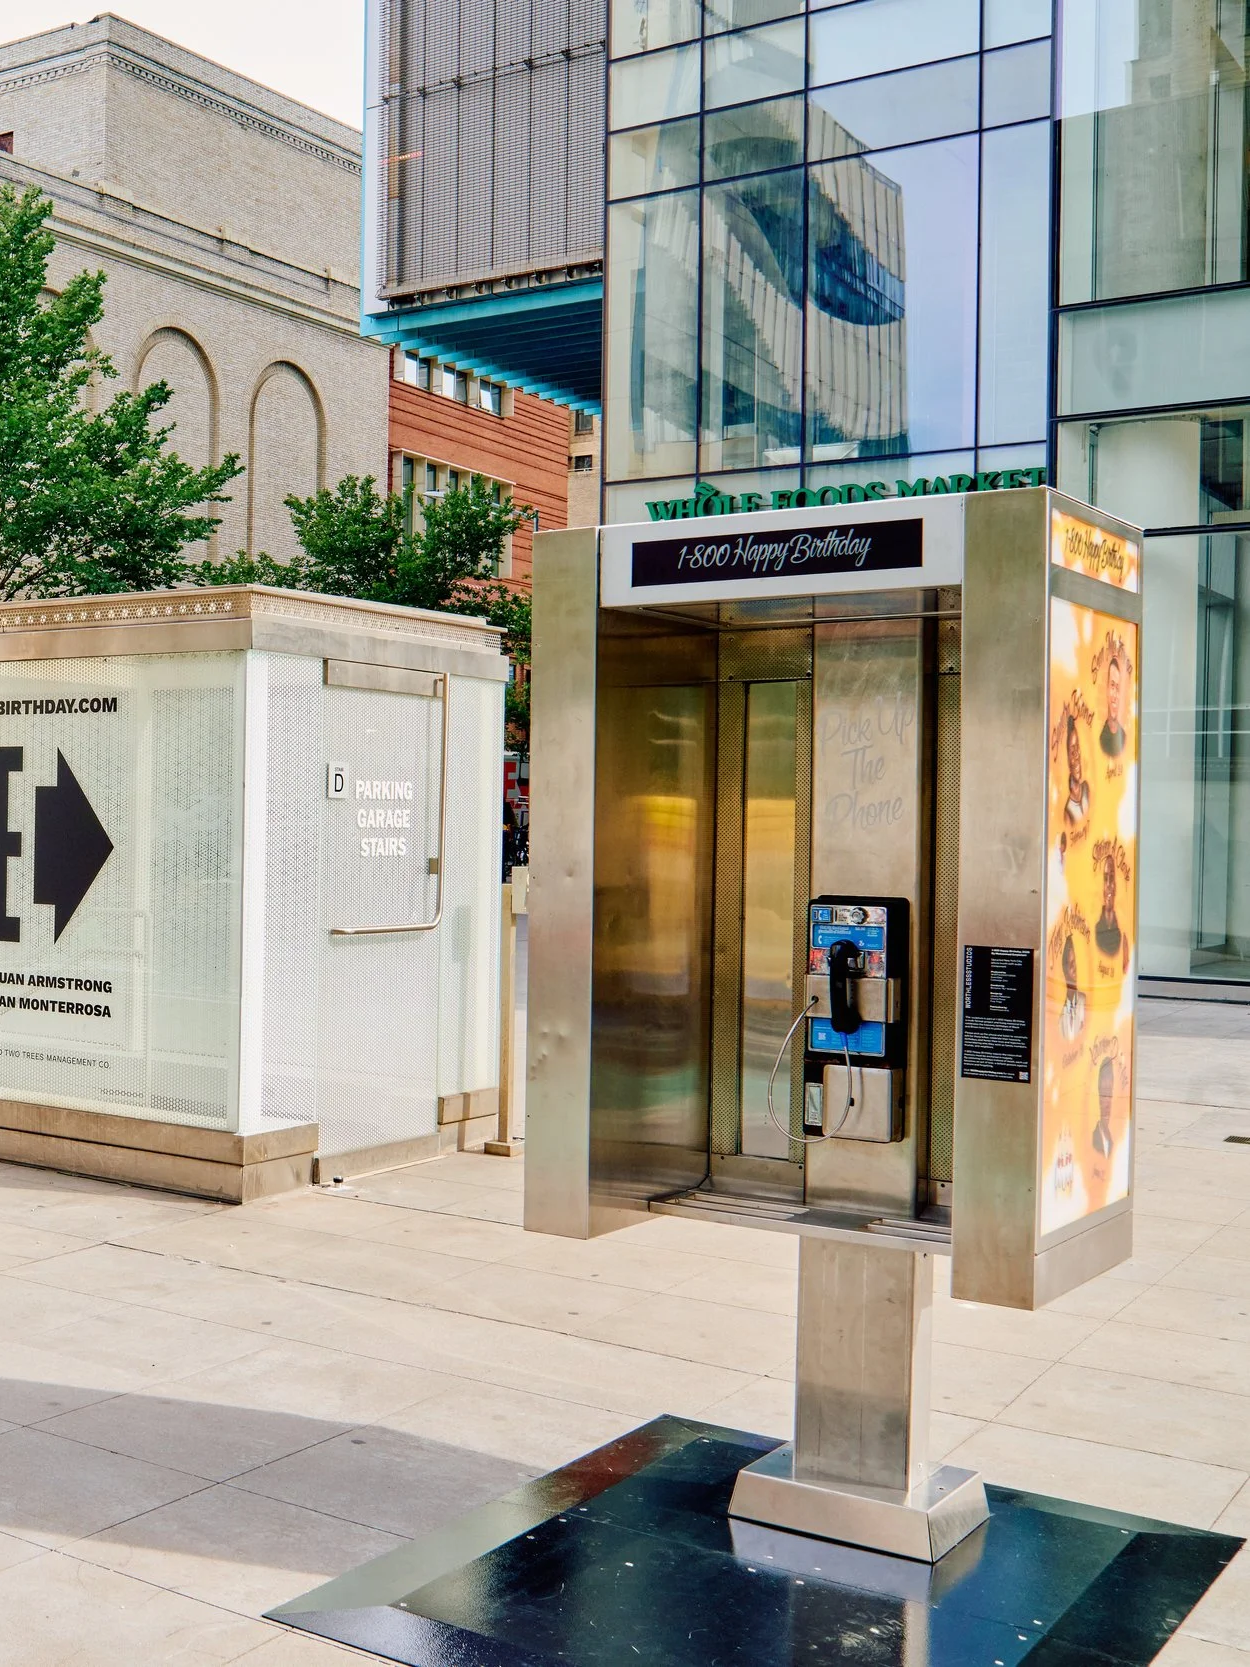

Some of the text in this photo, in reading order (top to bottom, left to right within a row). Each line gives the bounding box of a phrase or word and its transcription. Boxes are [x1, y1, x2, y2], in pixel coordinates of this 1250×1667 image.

[645, 466, 1047, 521] WHOLE FOODS MARKET
[677, 528, 872, 573] 1-800 Happy Birthday
[816, 691, 915, 757] Pick Up
[840, 744, 887, 791] The
[334, 773, 344, 792] D
[355, 780, 413, 800] PARKING
[357, 809, 411, 828] GARAGE
[825, 790, 904, 831] Phone
[360, 837, 407, 858] STAIRS
[28, 974, 113, 994] ARMSTRONG
[19, 997, 112, 1018] MONTERROSA
[4, 1049, 20, 1058] TWO
[23, 1051, 44, 1061] TREES
[46, 1054, 97, 1067] MANAGEMENT
[98, 1060, 111, 1069] CO.
